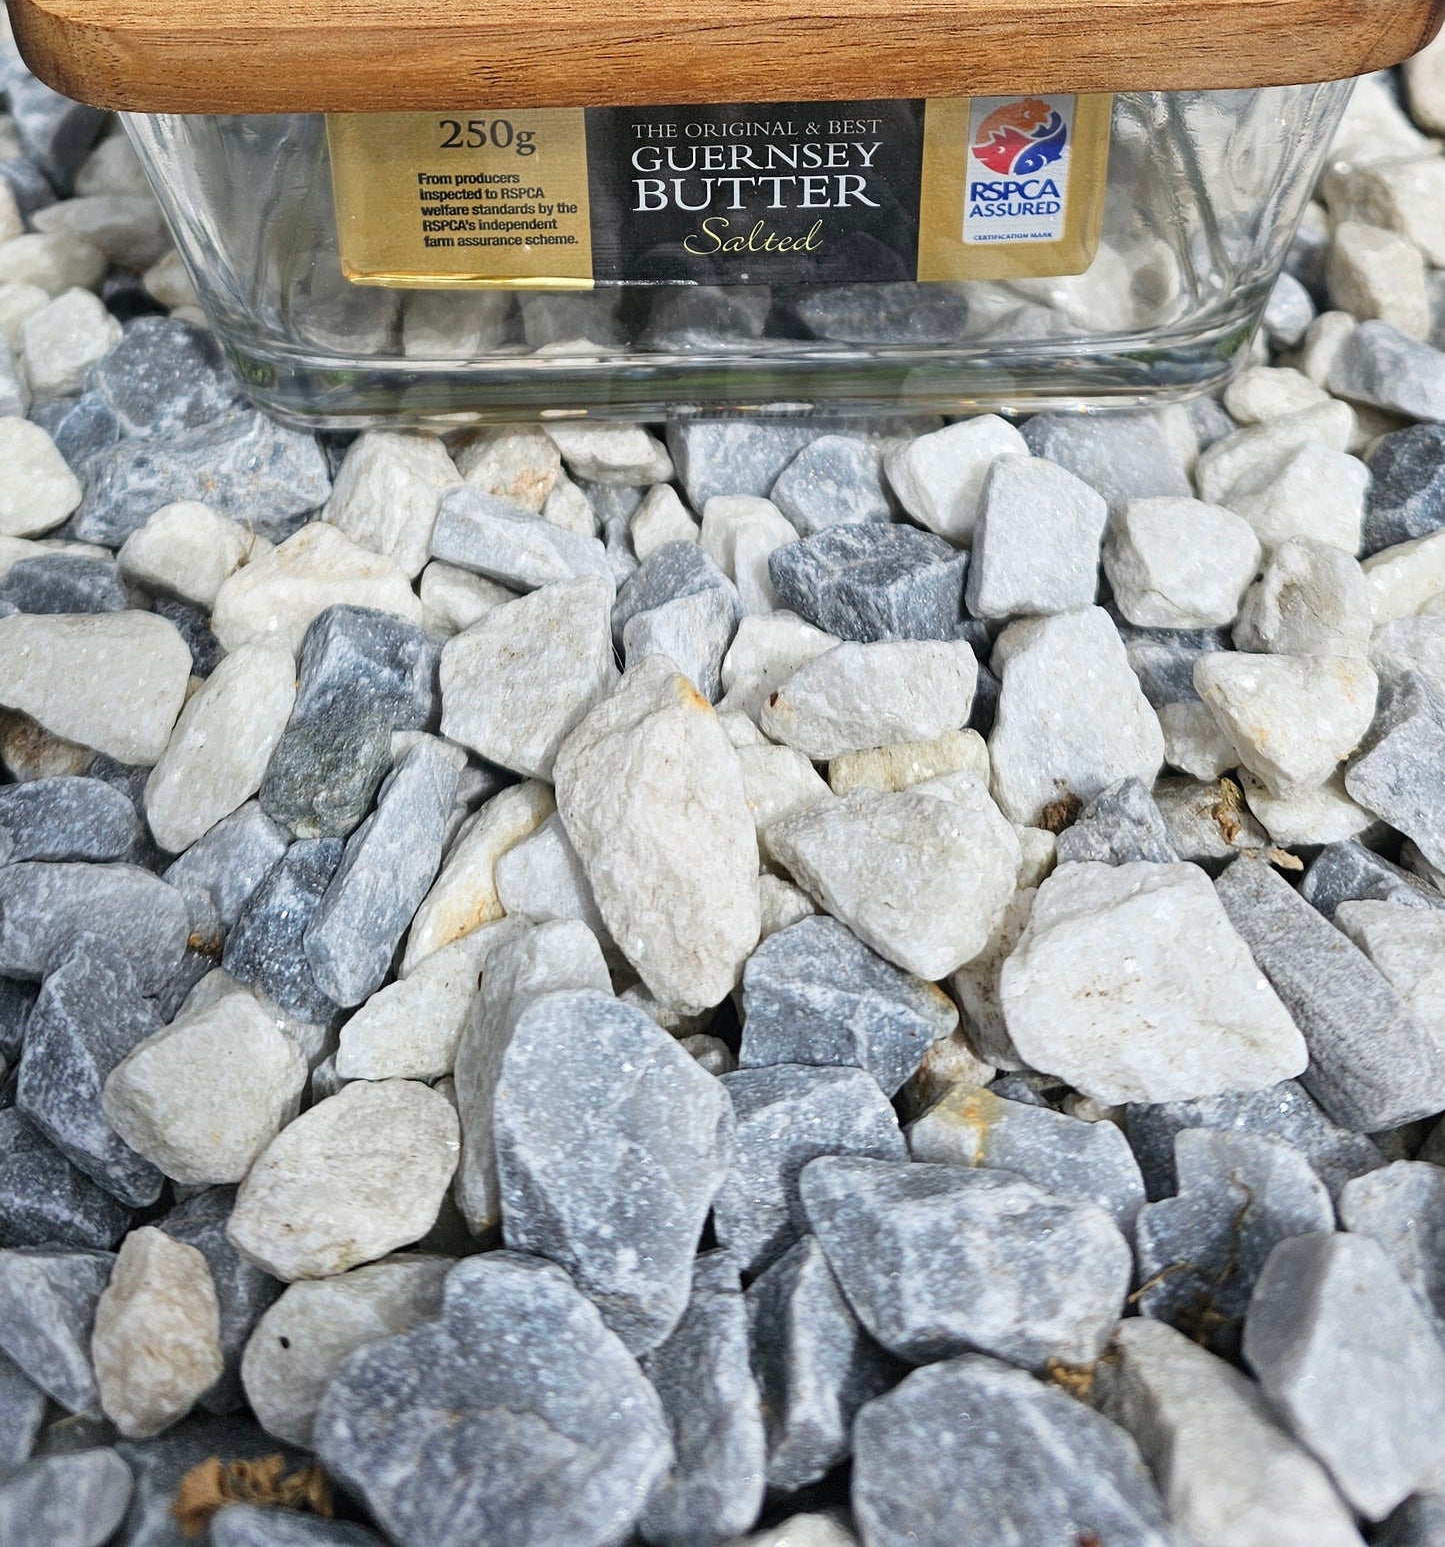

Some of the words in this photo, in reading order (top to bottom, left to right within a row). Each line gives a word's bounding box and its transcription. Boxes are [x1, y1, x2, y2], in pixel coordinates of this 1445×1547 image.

[439, 119, 536, 155] 250g
[631, 123, 678, 139] THE
[684, 121, 799, 138] ORIGINAL
[806, 121, 821, 136] &
[829, 119, 882, 134] BEST
[631, 141, 883, 172] GUERNSEY
[418, 172, 452, 185] From
[455, 171, 520, 186] producers
[419, 187, 482, 203] inspected
[485, 188, 498, 200] to
[501, 187, 545, 200] RSPCA
[632, 174, 881, 212] BUTTER
[970, 178, 1060, 201] RSPCA
[421, 203, 469, 217] welfare
[472, 202, 535, 216] standards
[538, 203, 555, 217] by
[556, 202, 578, 214] the
[969, 201, 1061, 218] ASSURED
[422, 219, 476, 232] RSPCA's
[478, 218, 558, 232] independent
[424, 234, 455, 248] farm
[457, 235, 522, 247] assurance
[524, 233, 579, 246] scheme.
[683, 216, 823, 255] Salted
[973, 233, 1029, 241] CERTIFICATION
